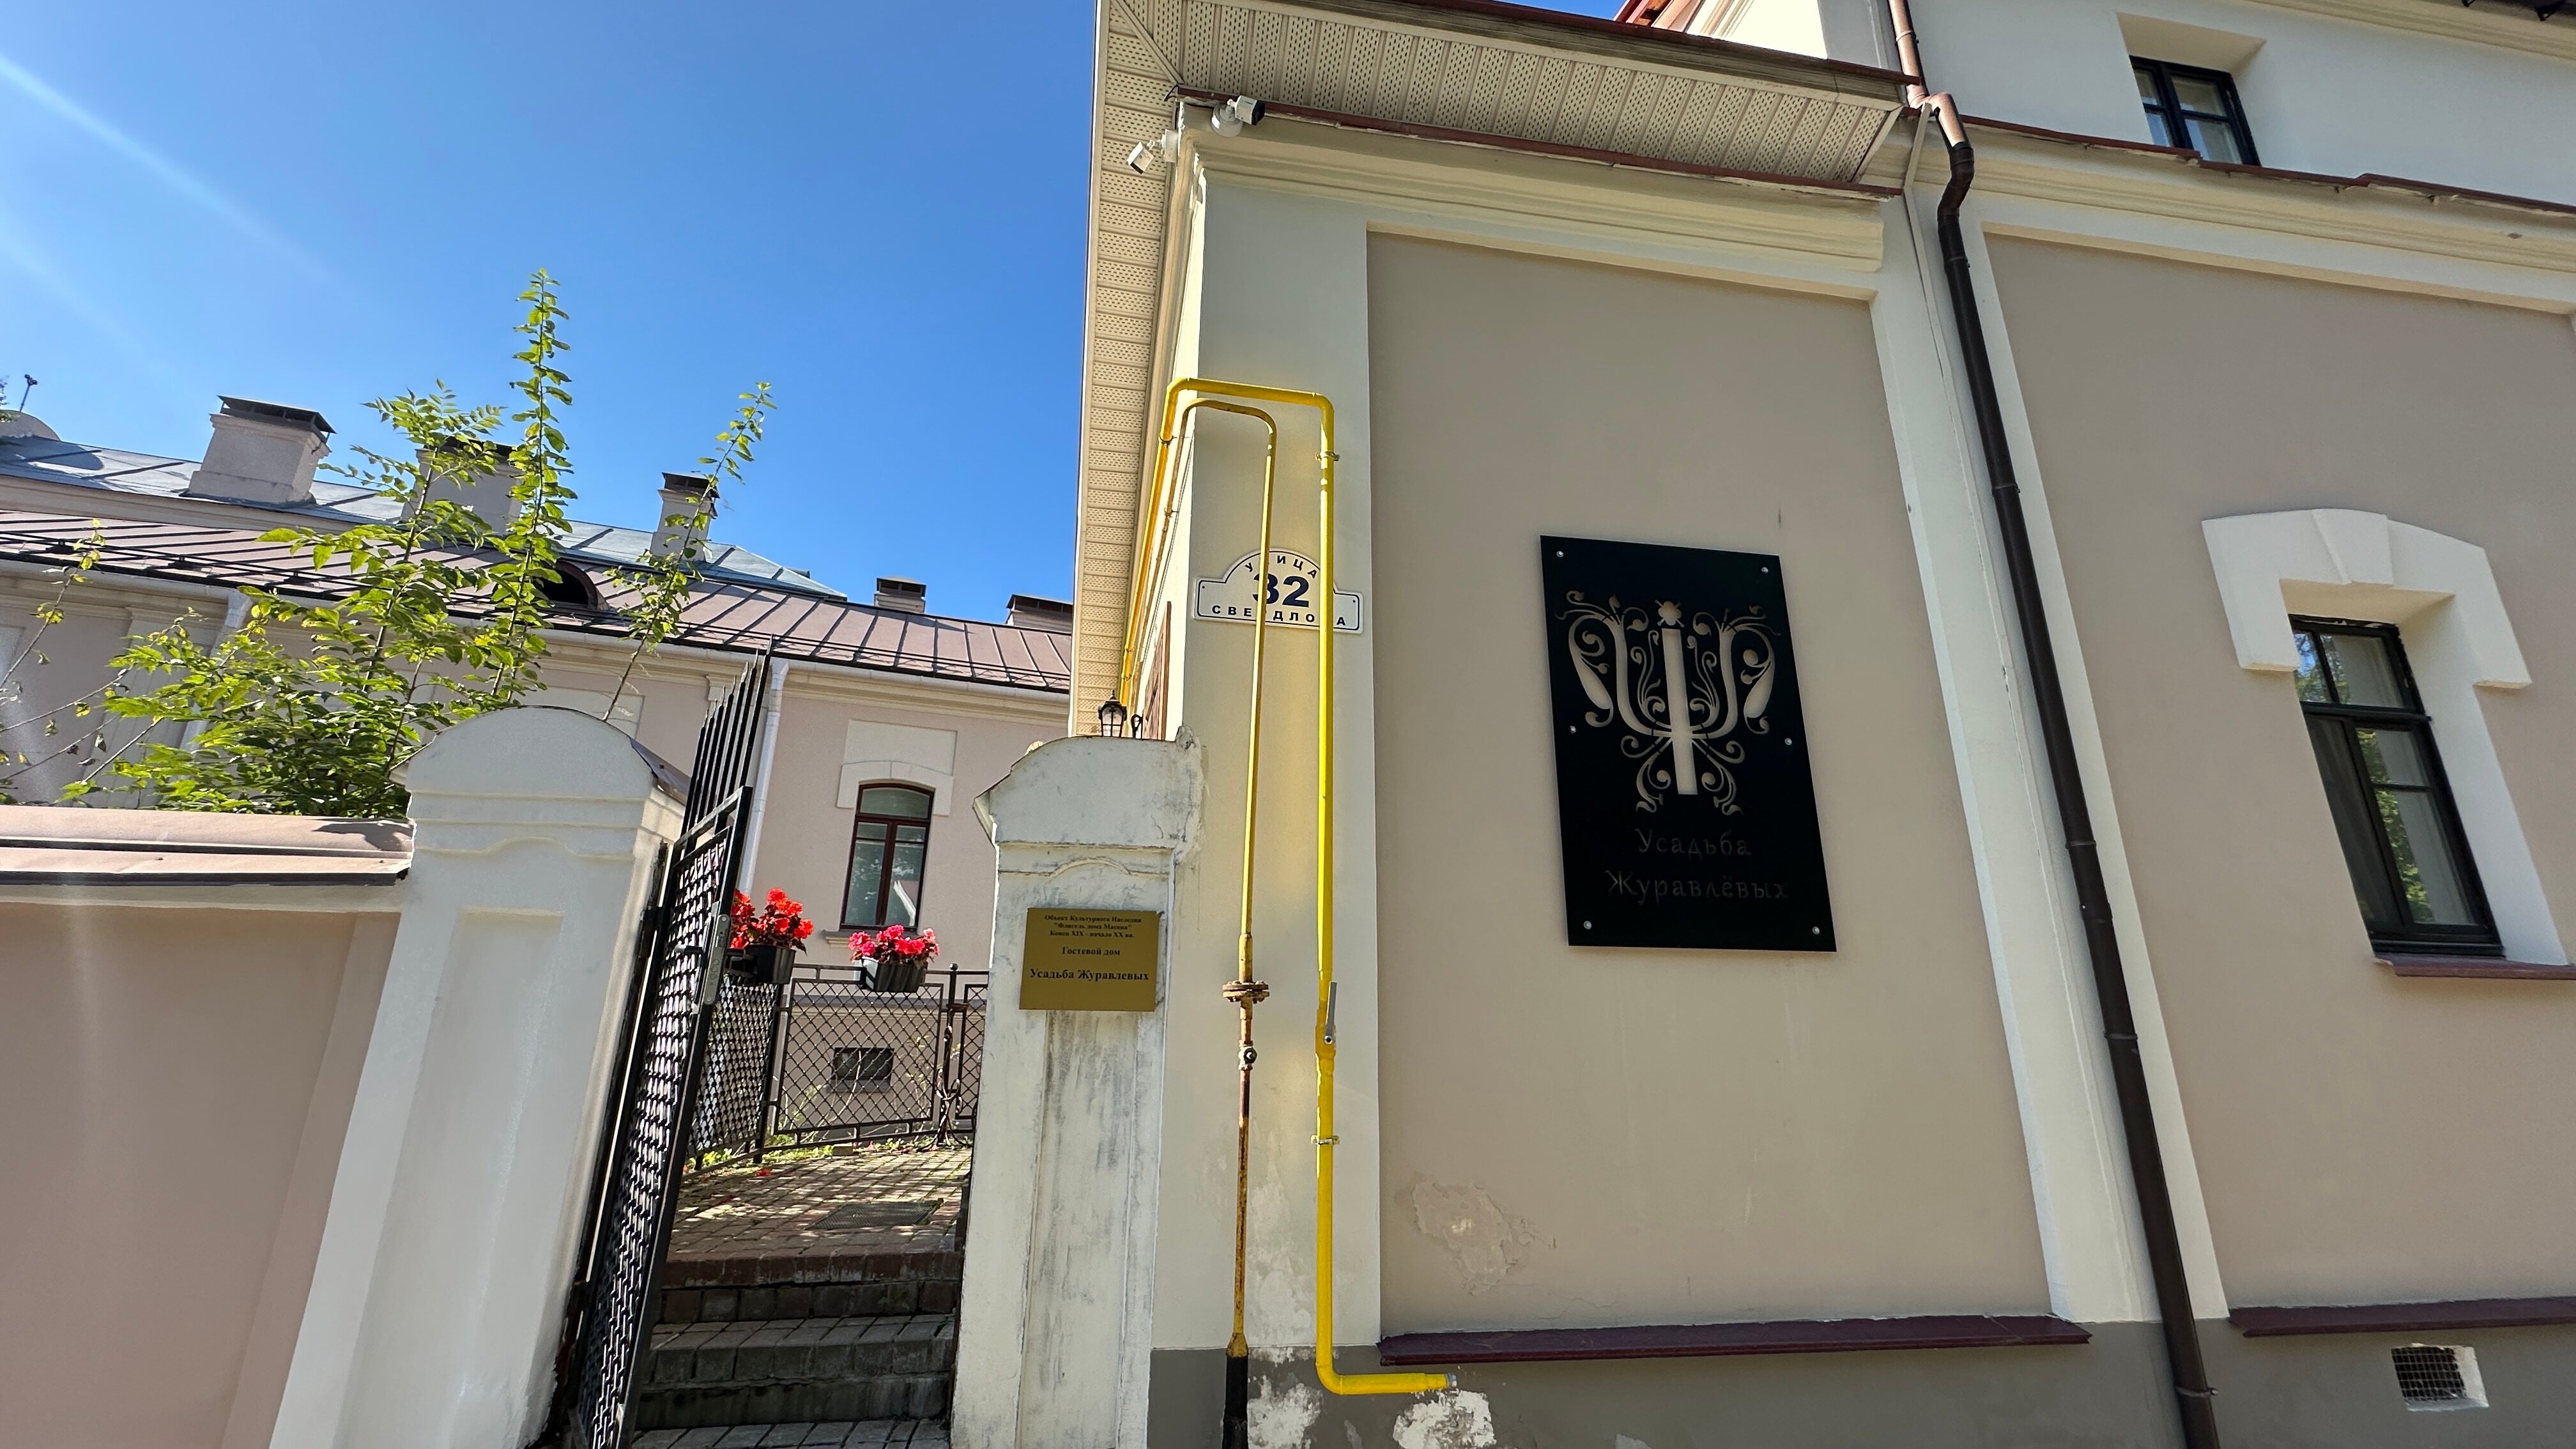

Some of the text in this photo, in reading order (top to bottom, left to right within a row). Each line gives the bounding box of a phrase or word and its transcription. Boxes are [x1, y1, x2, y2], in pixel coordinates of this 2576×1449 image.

[1245, 555, 1317, 579] УИЦА
[1252, 573, 1309, 608] 32
[1212, 605, 1346, 626] СВЕДЛОА
[1634, 828, 1751, 861] Усадьба
[1604, 870, 1789, 906] Журавлёвых
[1062, 946, 1101, 956] Гостевой
[1030, 968, 1149, 981] Усадьба Журавлевых
